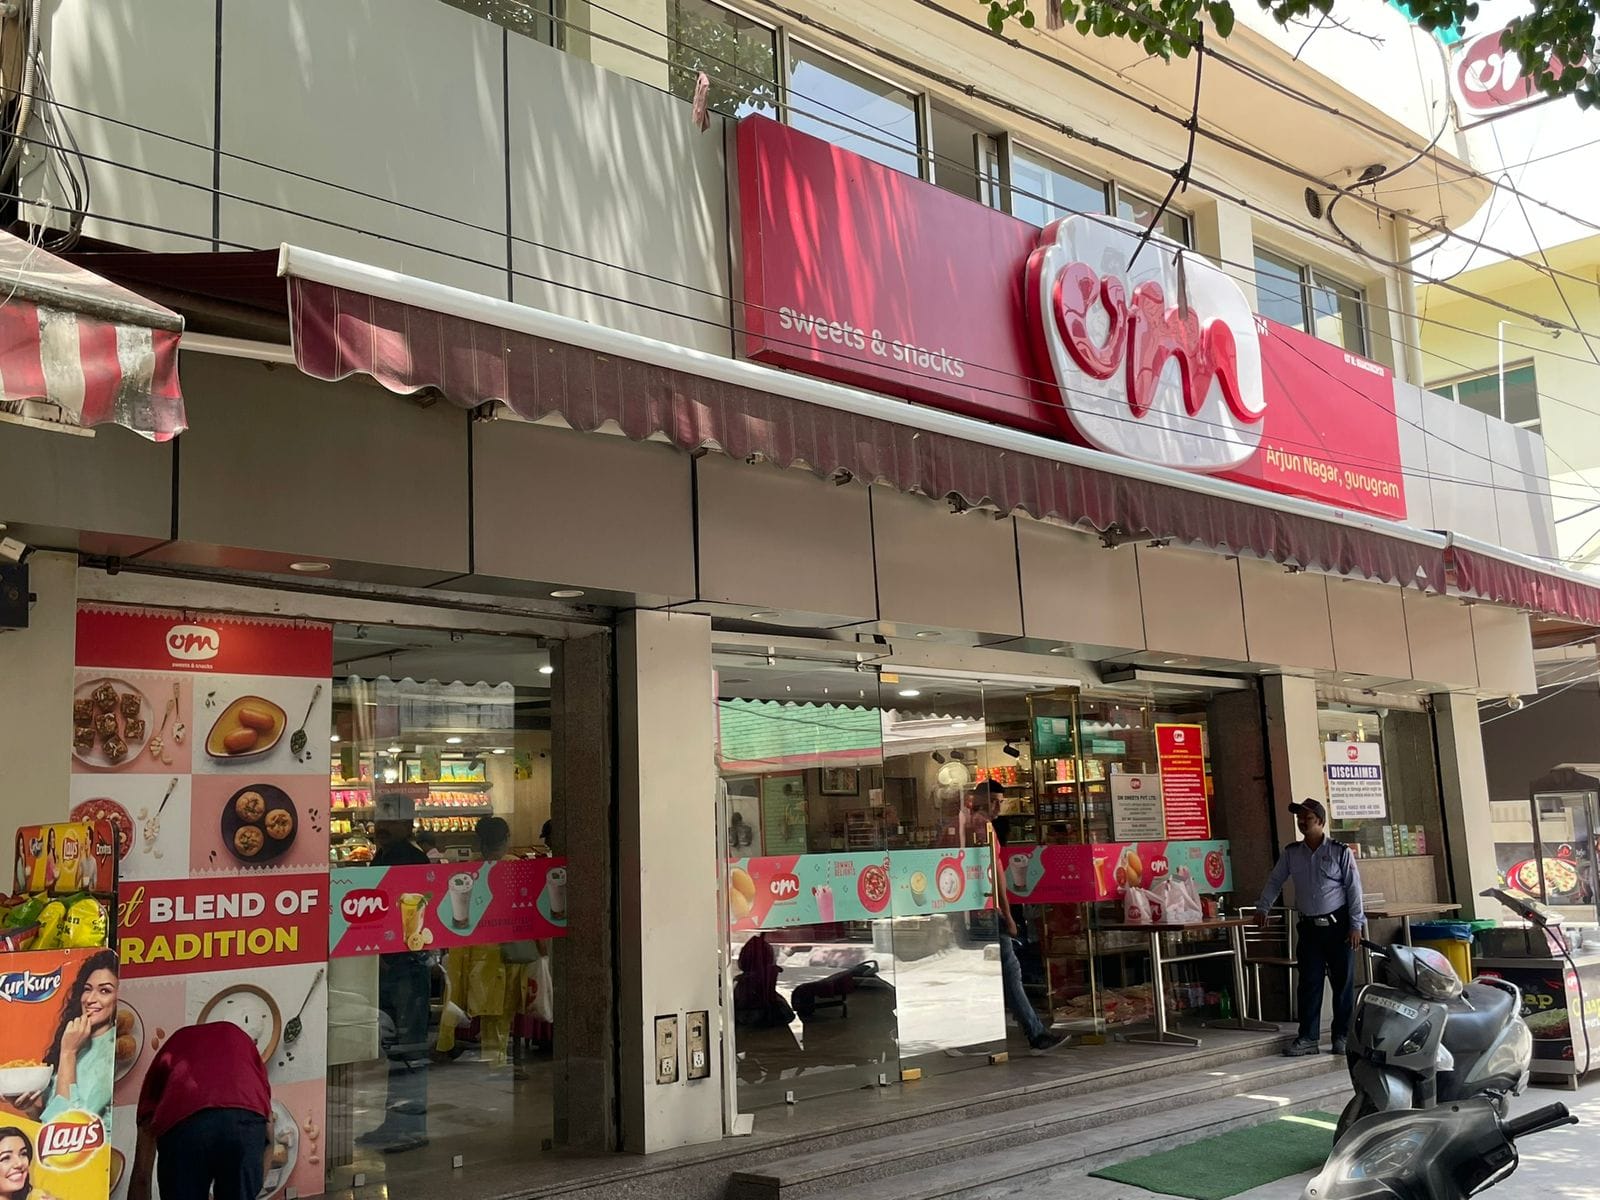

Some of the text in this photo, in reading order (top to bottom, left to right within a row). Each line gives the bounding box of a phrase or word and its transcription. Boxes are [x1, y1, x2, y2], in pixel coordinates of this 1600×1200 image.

[779, 306, 965, 378] sweets & snacks
[1053, 261, 1265, 424] om
[1266, 445, 1400, 499] Arjun Nagar, gurugram
[169, 633, 219, 653] om
[1331, 766, 1378, 778] DISCLAIMER
[1151, 859, 1168, 872] om
[770, 879, 799, 896] om
[150, 892, 265, 923] BLEND
[275, 889, 319, 915] OF
[343, 896, 389, 918] om
[117, 926, 298, 965] RADITION
[41, 1122, 100, 1155] Lay's
